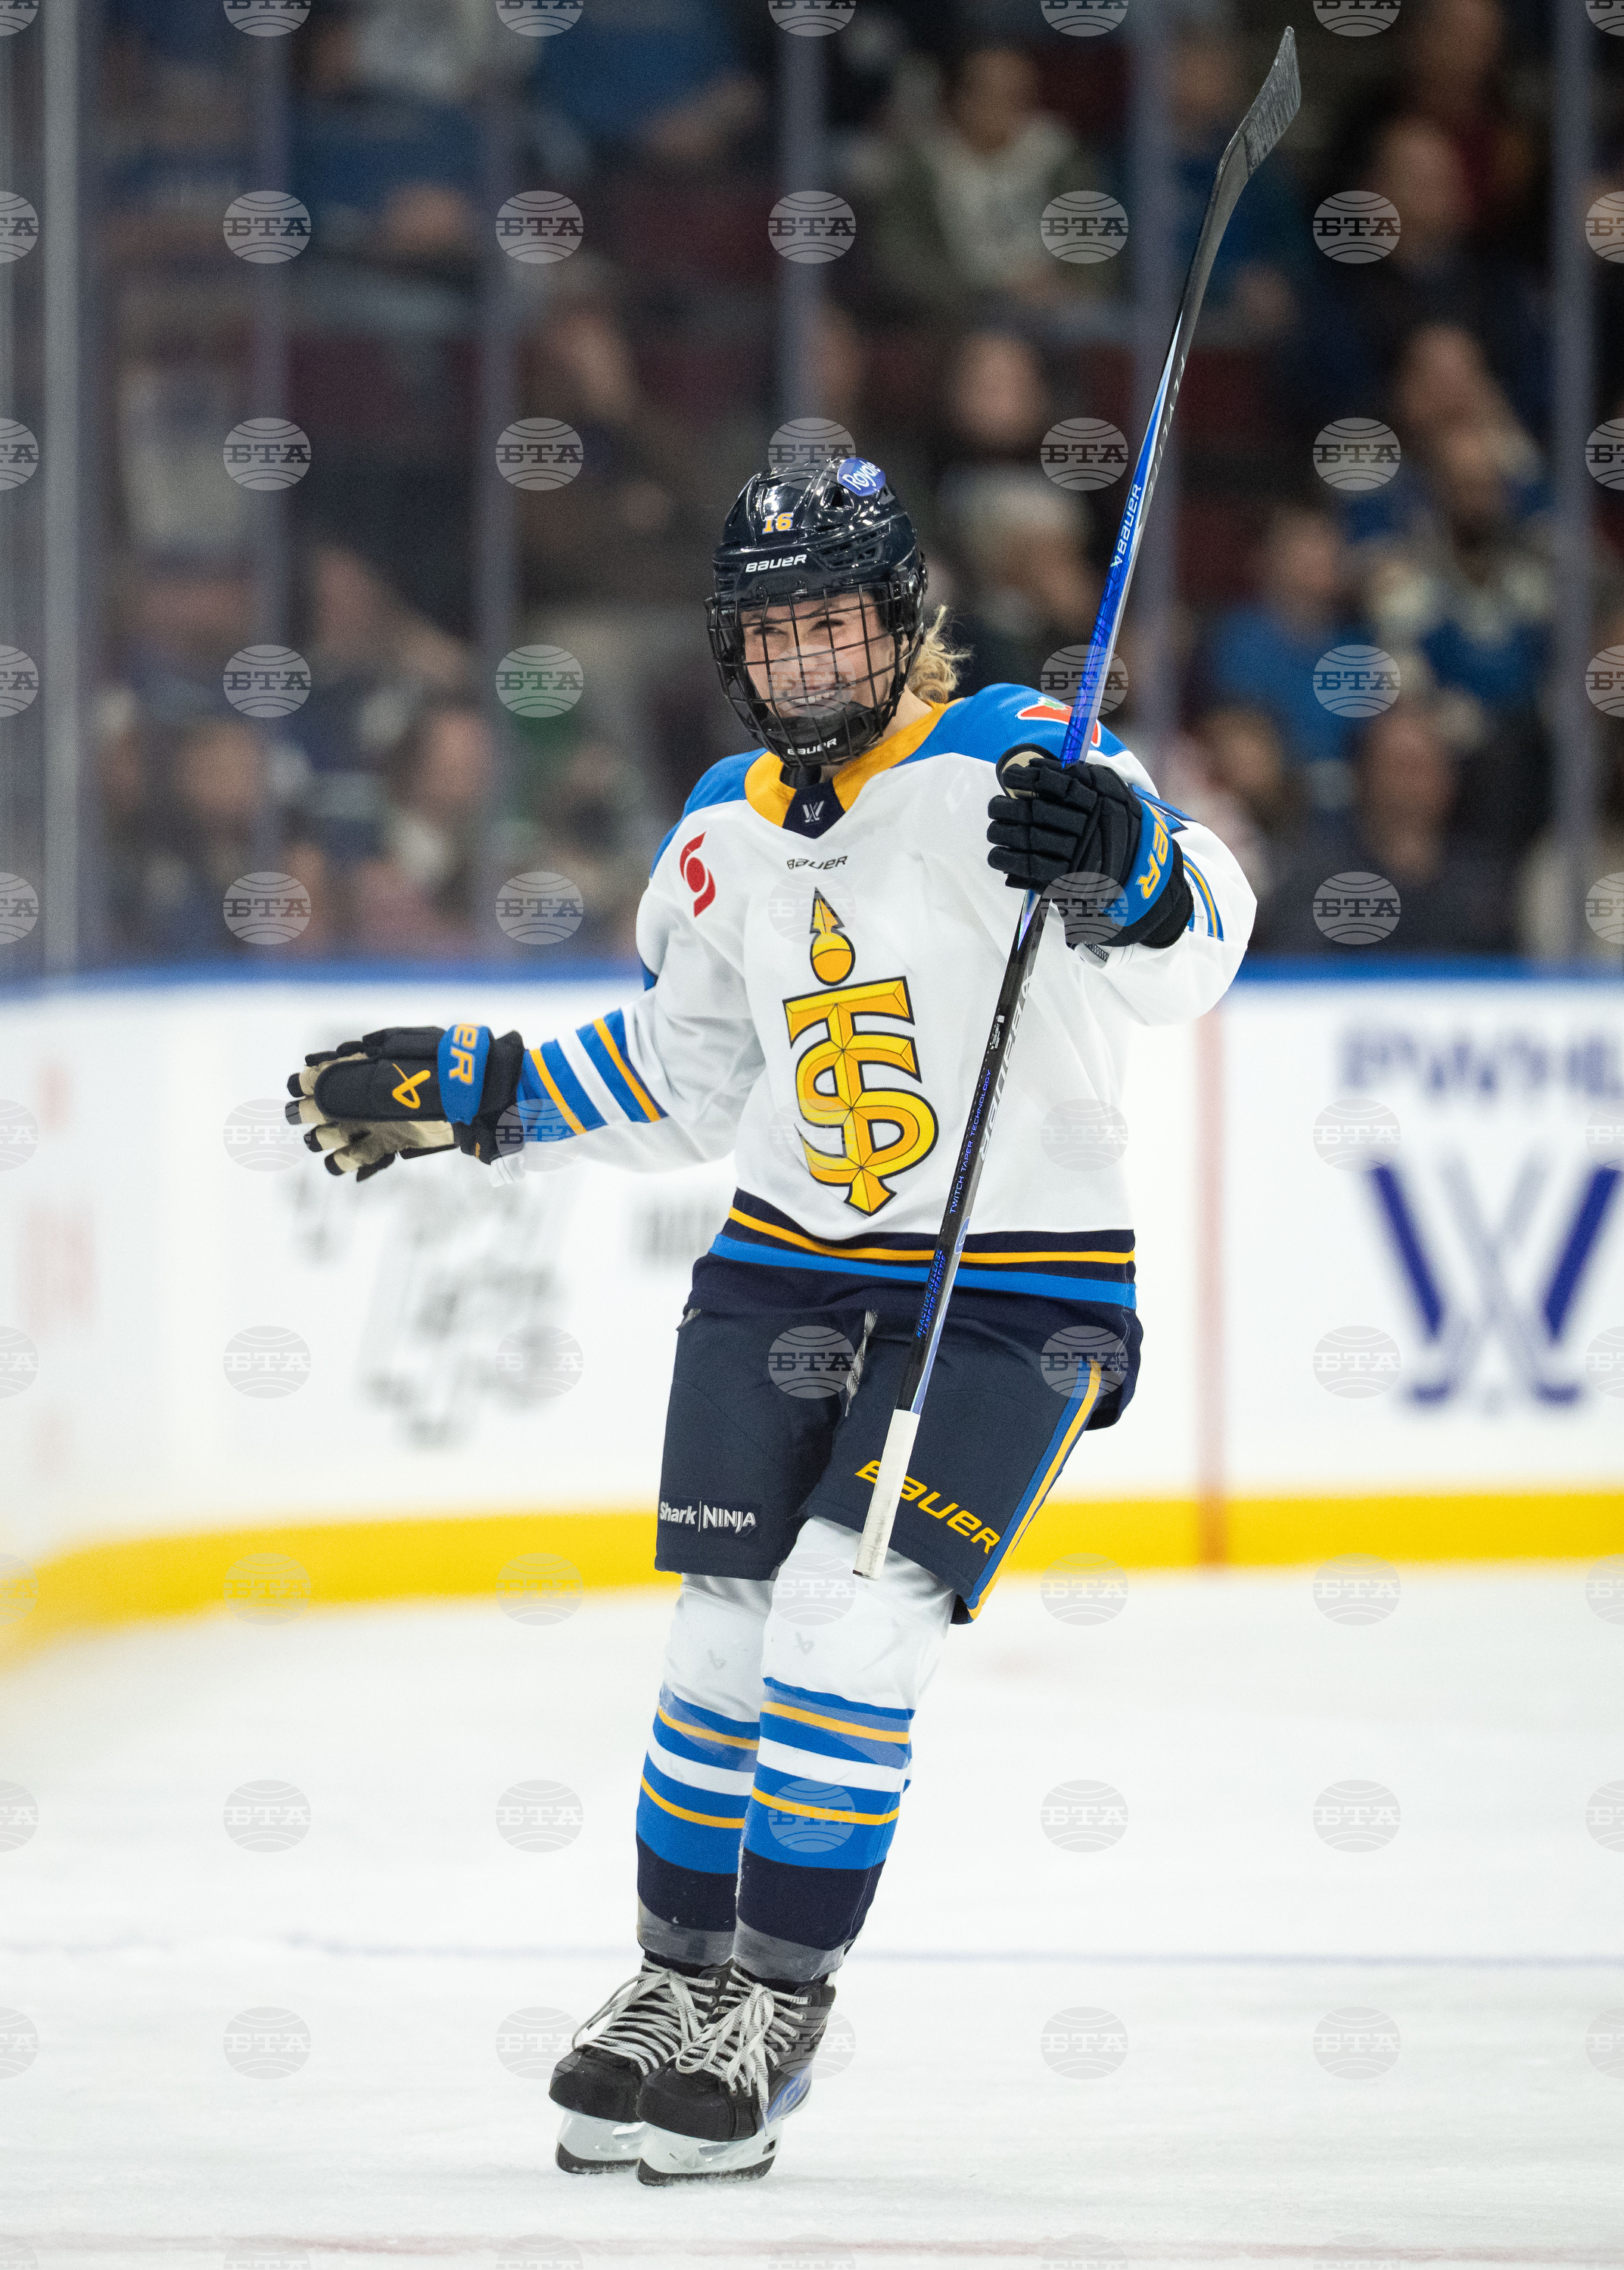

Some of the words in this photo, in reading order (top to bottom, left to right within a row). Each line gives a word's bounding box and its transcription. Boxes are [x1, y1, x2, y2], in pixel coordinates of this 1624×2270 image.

[842, 460, 882, 491] Royale
[762, 512, 794, 534] 16
[1117, 484, 1142, 555] BAUER
[745, 554, 807, 573] BAUER
[787, 738, 837, 755] BAUER
[786, 855, 848, 869] BAUER
[949, 1175, 965, 1214] TWITCH
[960, 1140, 974, 1172] TAPER
[969, 1068, 991, 1137] TECHNOLOGY
[660, 1501, 698, 1525] Shark
[702, 1504, 757, 1534] NINJA
[854, 1460, 1000, 1554] BAUER
